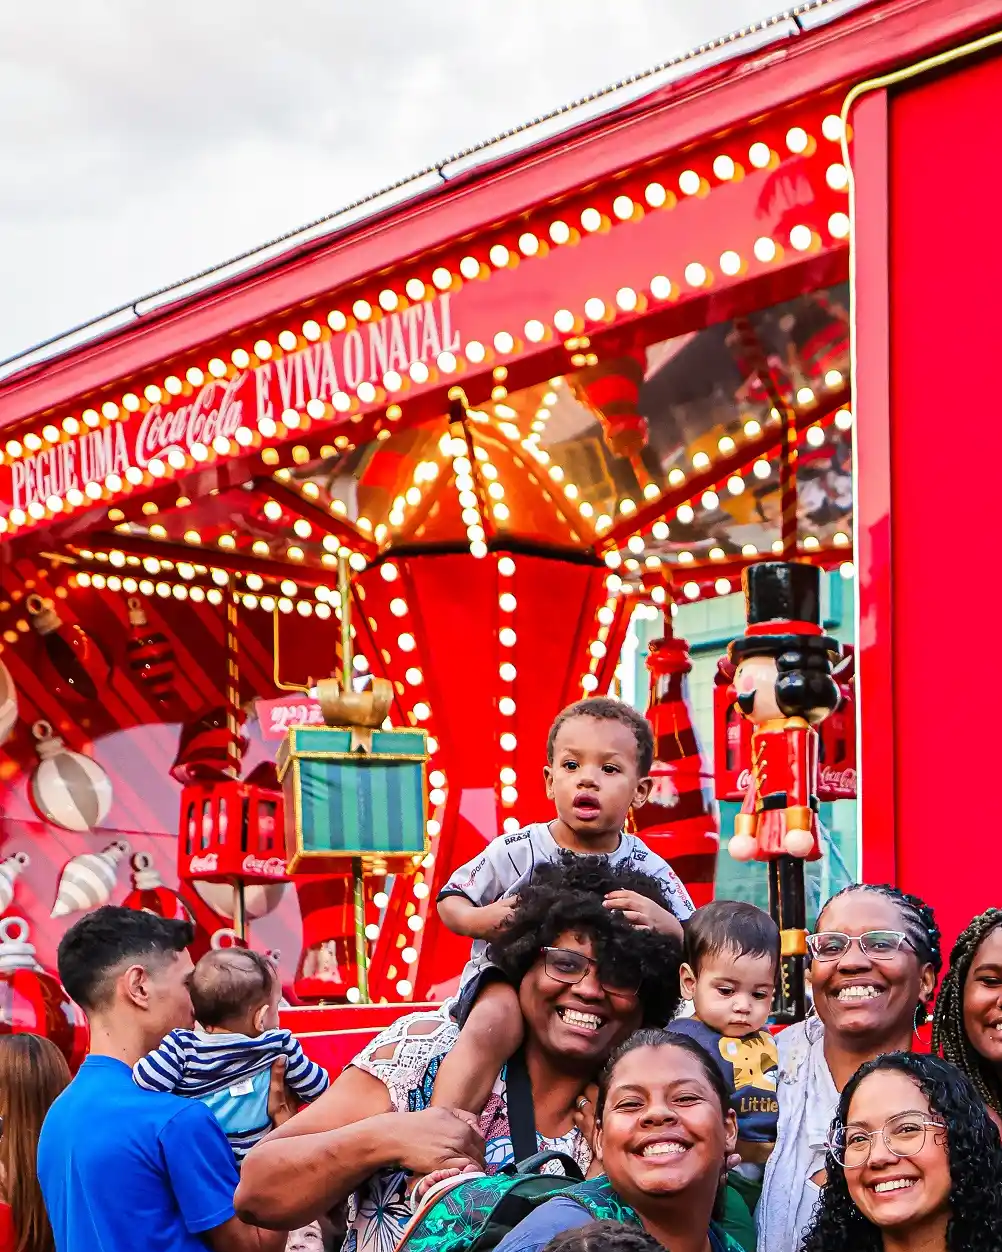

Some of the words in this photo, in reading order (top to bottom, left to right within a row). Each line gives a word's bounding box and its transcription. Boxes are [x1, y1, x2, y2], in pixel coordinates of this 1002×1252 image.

[12, 440, 79, 509] PEGUE
[79, 421, 131, 486] UMA
[254, 362, 274, 422] E
[275, 341, 340, 410] VIVA
[343, 329, 365, 390] O
[368, 292, 461, 382] NATAL
[740, 1096, 779, 1113] Little
